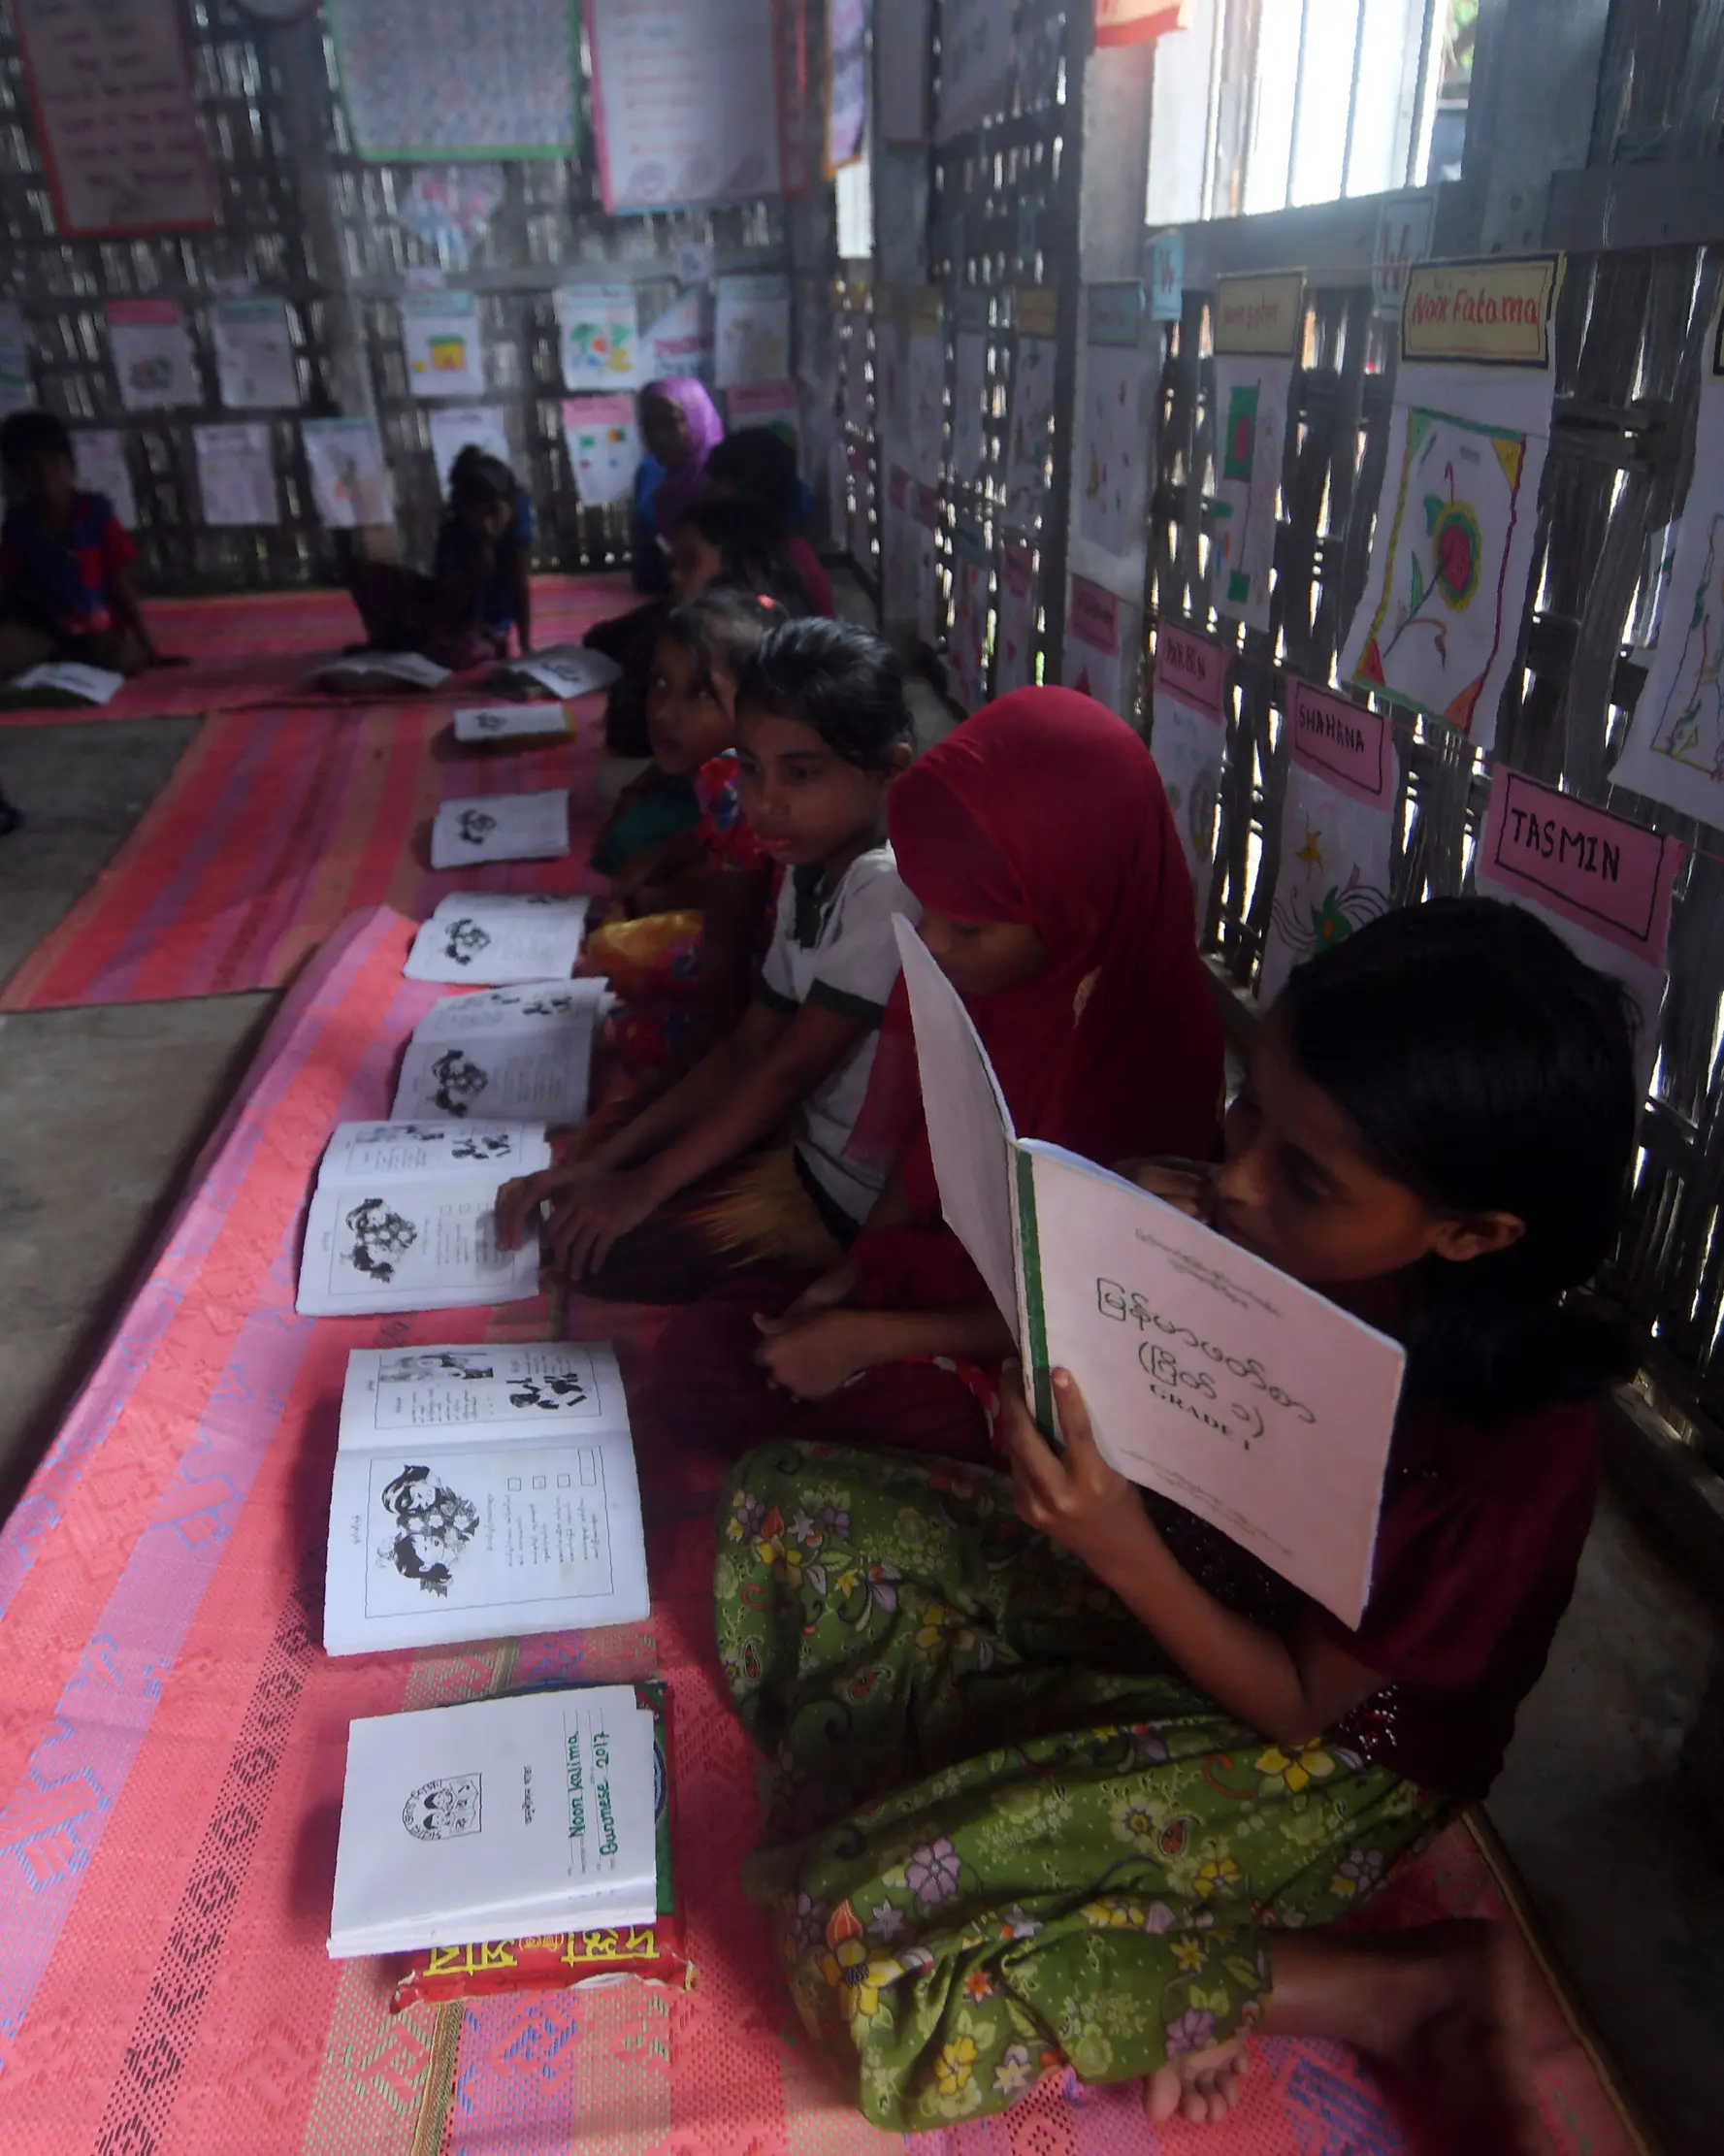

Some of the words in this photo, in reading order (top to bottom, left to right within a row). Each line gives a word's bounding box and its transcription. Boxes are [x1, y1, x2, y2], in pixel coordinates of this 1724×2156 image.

[1298, 706, 1365, 754] SHAHANA
[1511, 809, 1620, 883] TASMIN
[1150, 1383, 1233, 1437] GRADE
[593, 1731, 610, 1769] 2017
